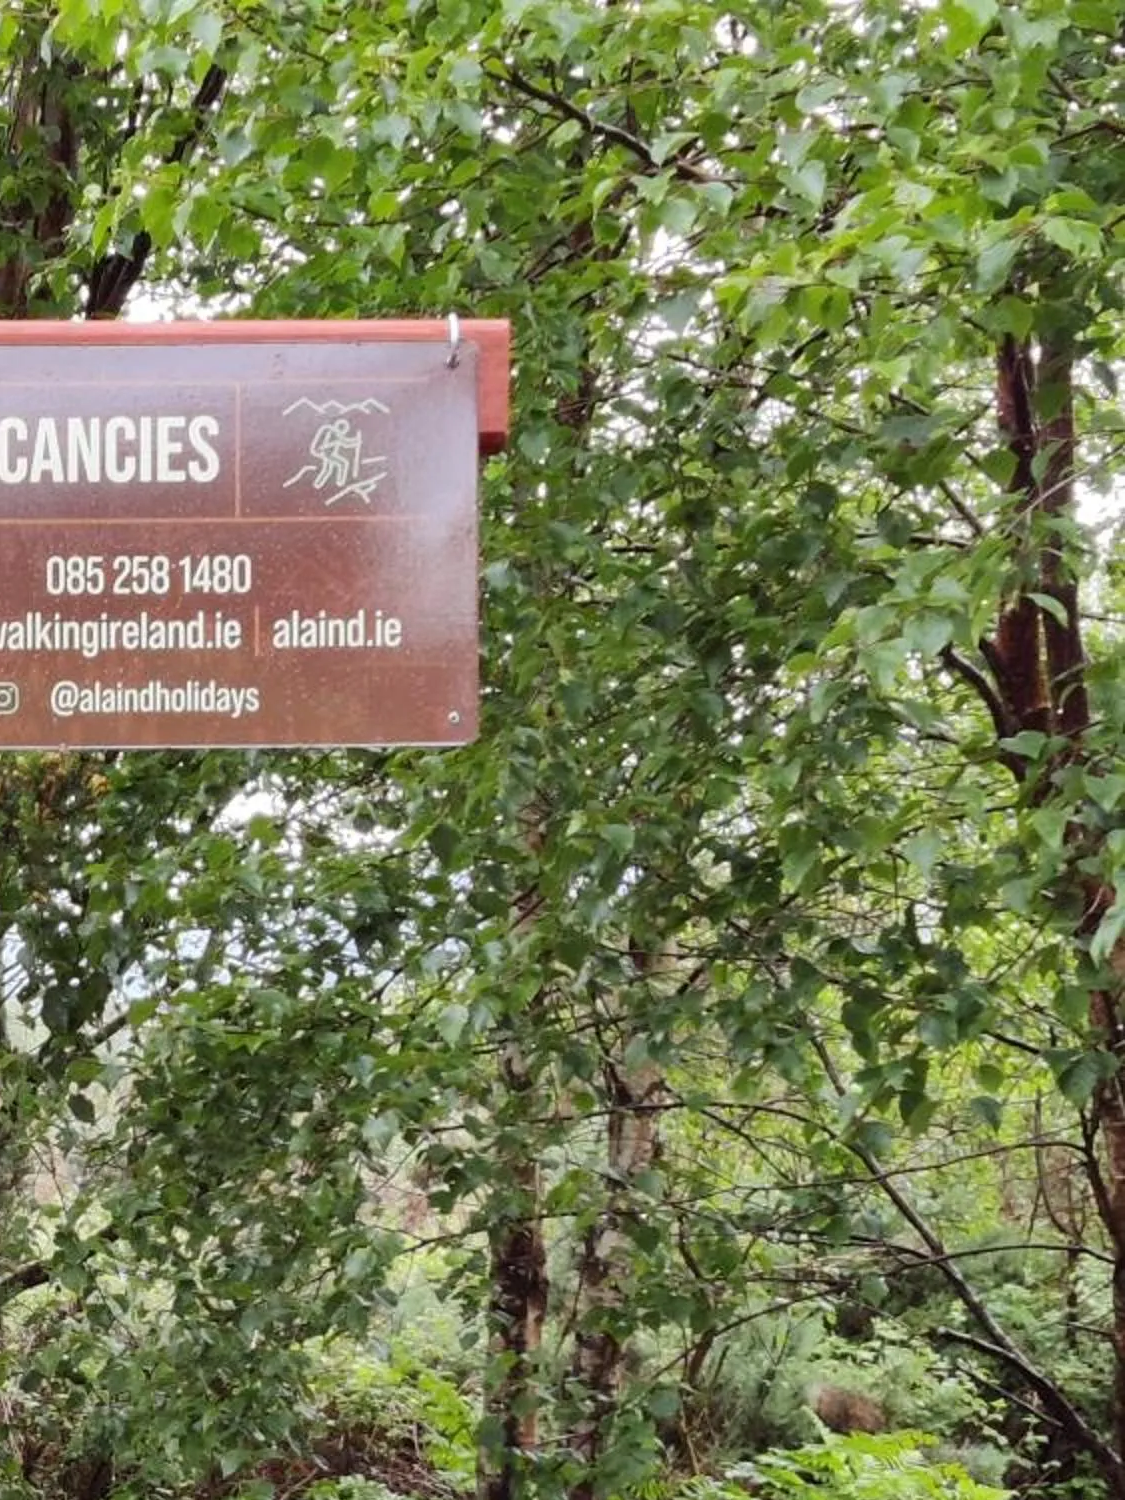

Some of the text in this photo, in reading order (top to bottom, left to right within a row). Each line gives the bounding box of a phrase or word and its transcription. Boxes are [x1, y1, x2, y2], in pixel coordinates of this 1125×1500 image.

[45, 553, 252, 596] 085 258 1480
[272, 609, 403, 650] alaind.ie
[50, 680, 260, 719] @alaindholidays
